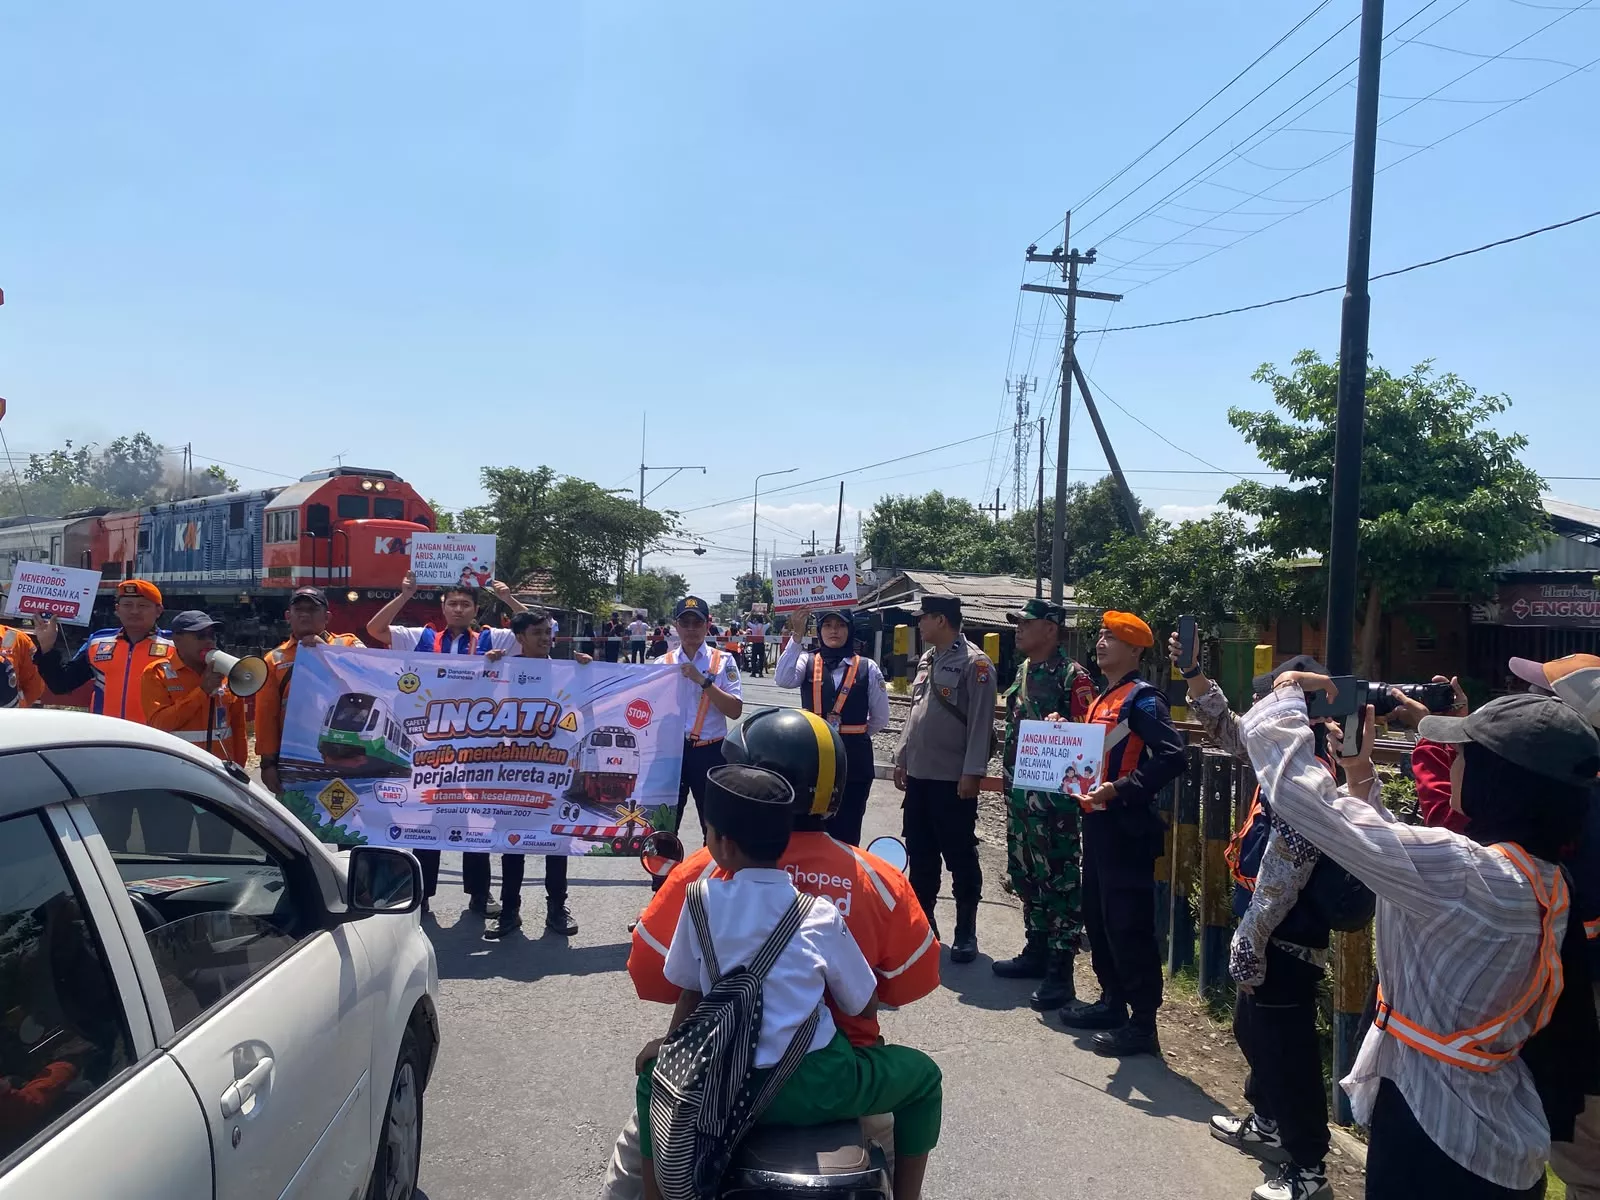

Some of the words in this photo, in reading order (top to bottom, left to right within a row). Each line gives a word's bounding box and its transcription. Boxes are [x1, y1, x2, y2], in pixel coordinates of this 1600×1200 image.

[174, 521, 202, 552] KAI
[415, 552, 435, 560] ARUS,
[415, 570, 438, 578] ORANG
[776, 566, 818, 577] MENEMPER
[820, 564, 848, 573] KERETA
[20, 573, 66, 586] MENEROBOS
[777, 577, 810, 587] SAKITNYA
[17, 584, 68, 598] PERLINTASAN
[69, 591, 79, 599] KA
[778, 589, 799, 597] DISINI
[24, 600, 50, 610] GAME
[52, 604, 75, 613] OVER
[426, 700, 558, 736] INGAT!
[628, 707, 649, 721] STOP!
[406, 718, 428, 727] SAFETY
[1022, 734, 1046, 744] JANGAN
[1049, 735, 1082, 746] MELAWAN
[414, 744, 455, 767] wajib
[458, 742, 568, 764] mendahulukan
[1020, 746, 1040, 756] ARUS,
[1041, 747, 1069, 758] APALAGI
[1020, 758, 1051, 768] MELAWAN
[413, 766, 494, 789] perjalanan
[498, 764, 544, 783] kereta
[548, 768, 572, 789] api
[1018, 768, 1040, 780] ORANG
[1042, 770, 1054, 781] TUA
[432, 790, 478, 800] utamakan
[481, 791, 544, 804] keselamatan!
[784, 864, 852, 890] Shopee
